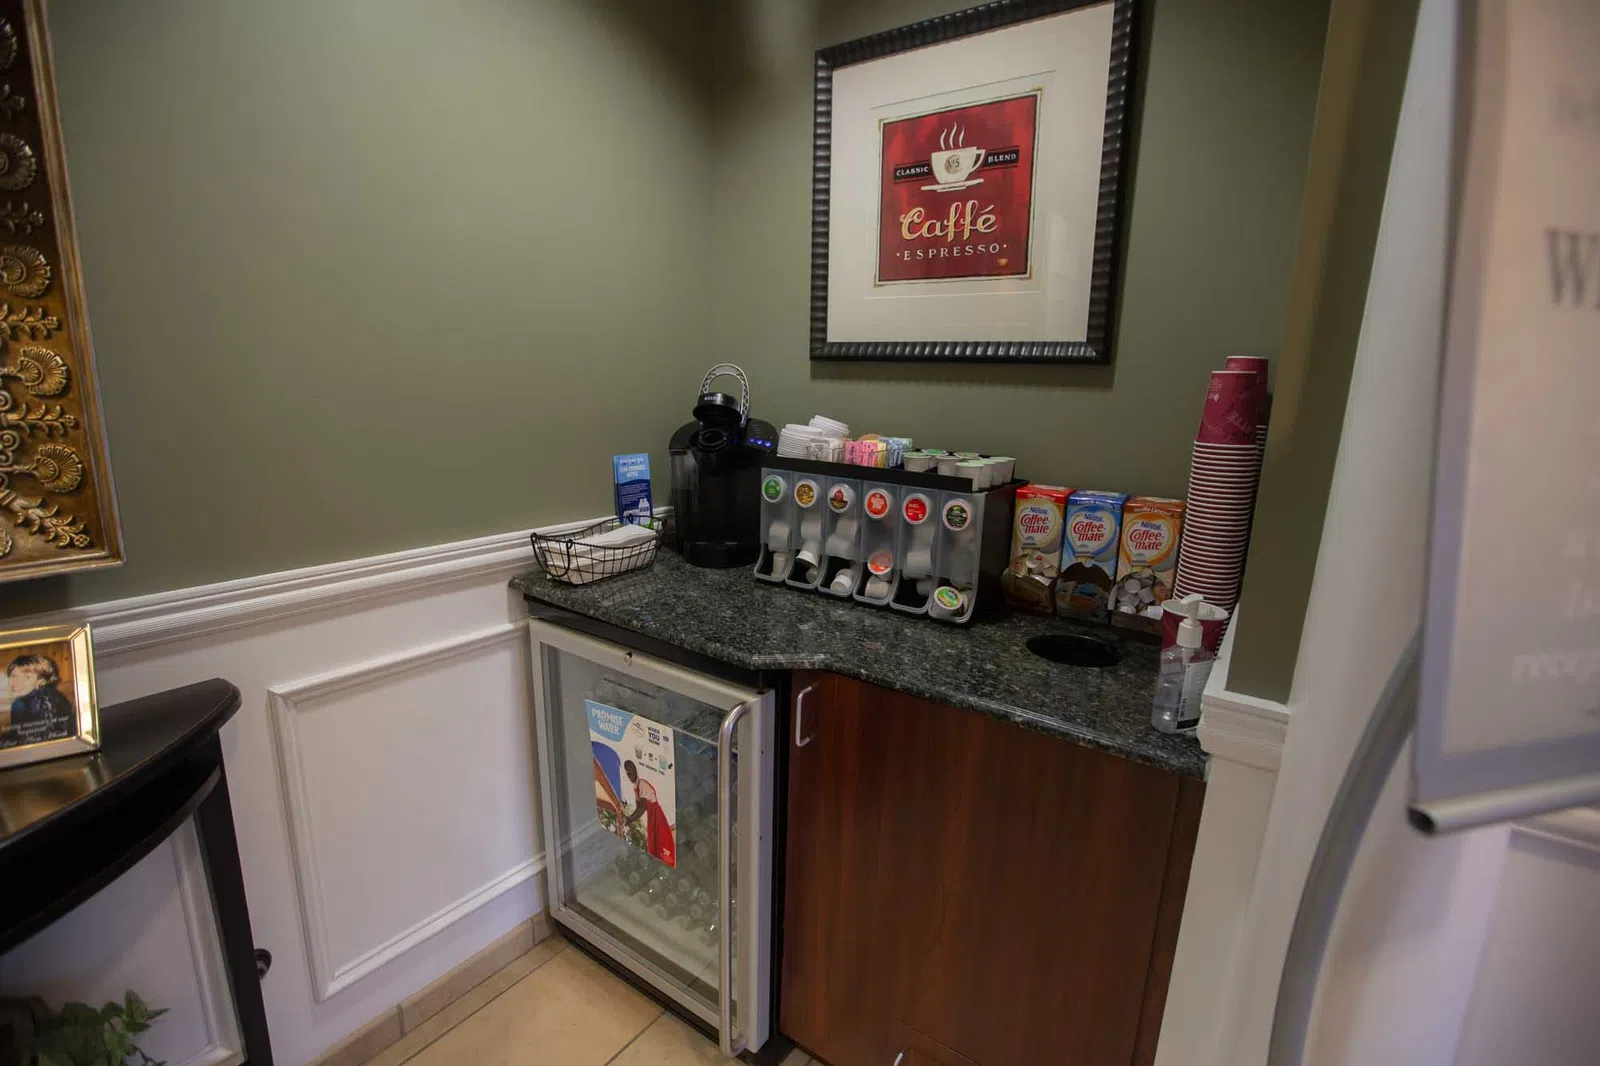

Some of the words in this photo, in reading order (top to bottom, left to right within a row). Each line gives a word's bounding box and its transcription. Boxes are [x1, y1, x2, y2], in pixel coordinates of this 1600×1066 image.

[988, 153, 1017, 164] BLEND
[896, 165, 929, 177] CLASSIC
[900, 199, 999, 242] Caffé
[1023, 524, 1050, 534] mate
[1077, 532, 1105, 542] mate
[1134, 541, 1163, 551] mate
[648, 732, 660, 741] YOU
